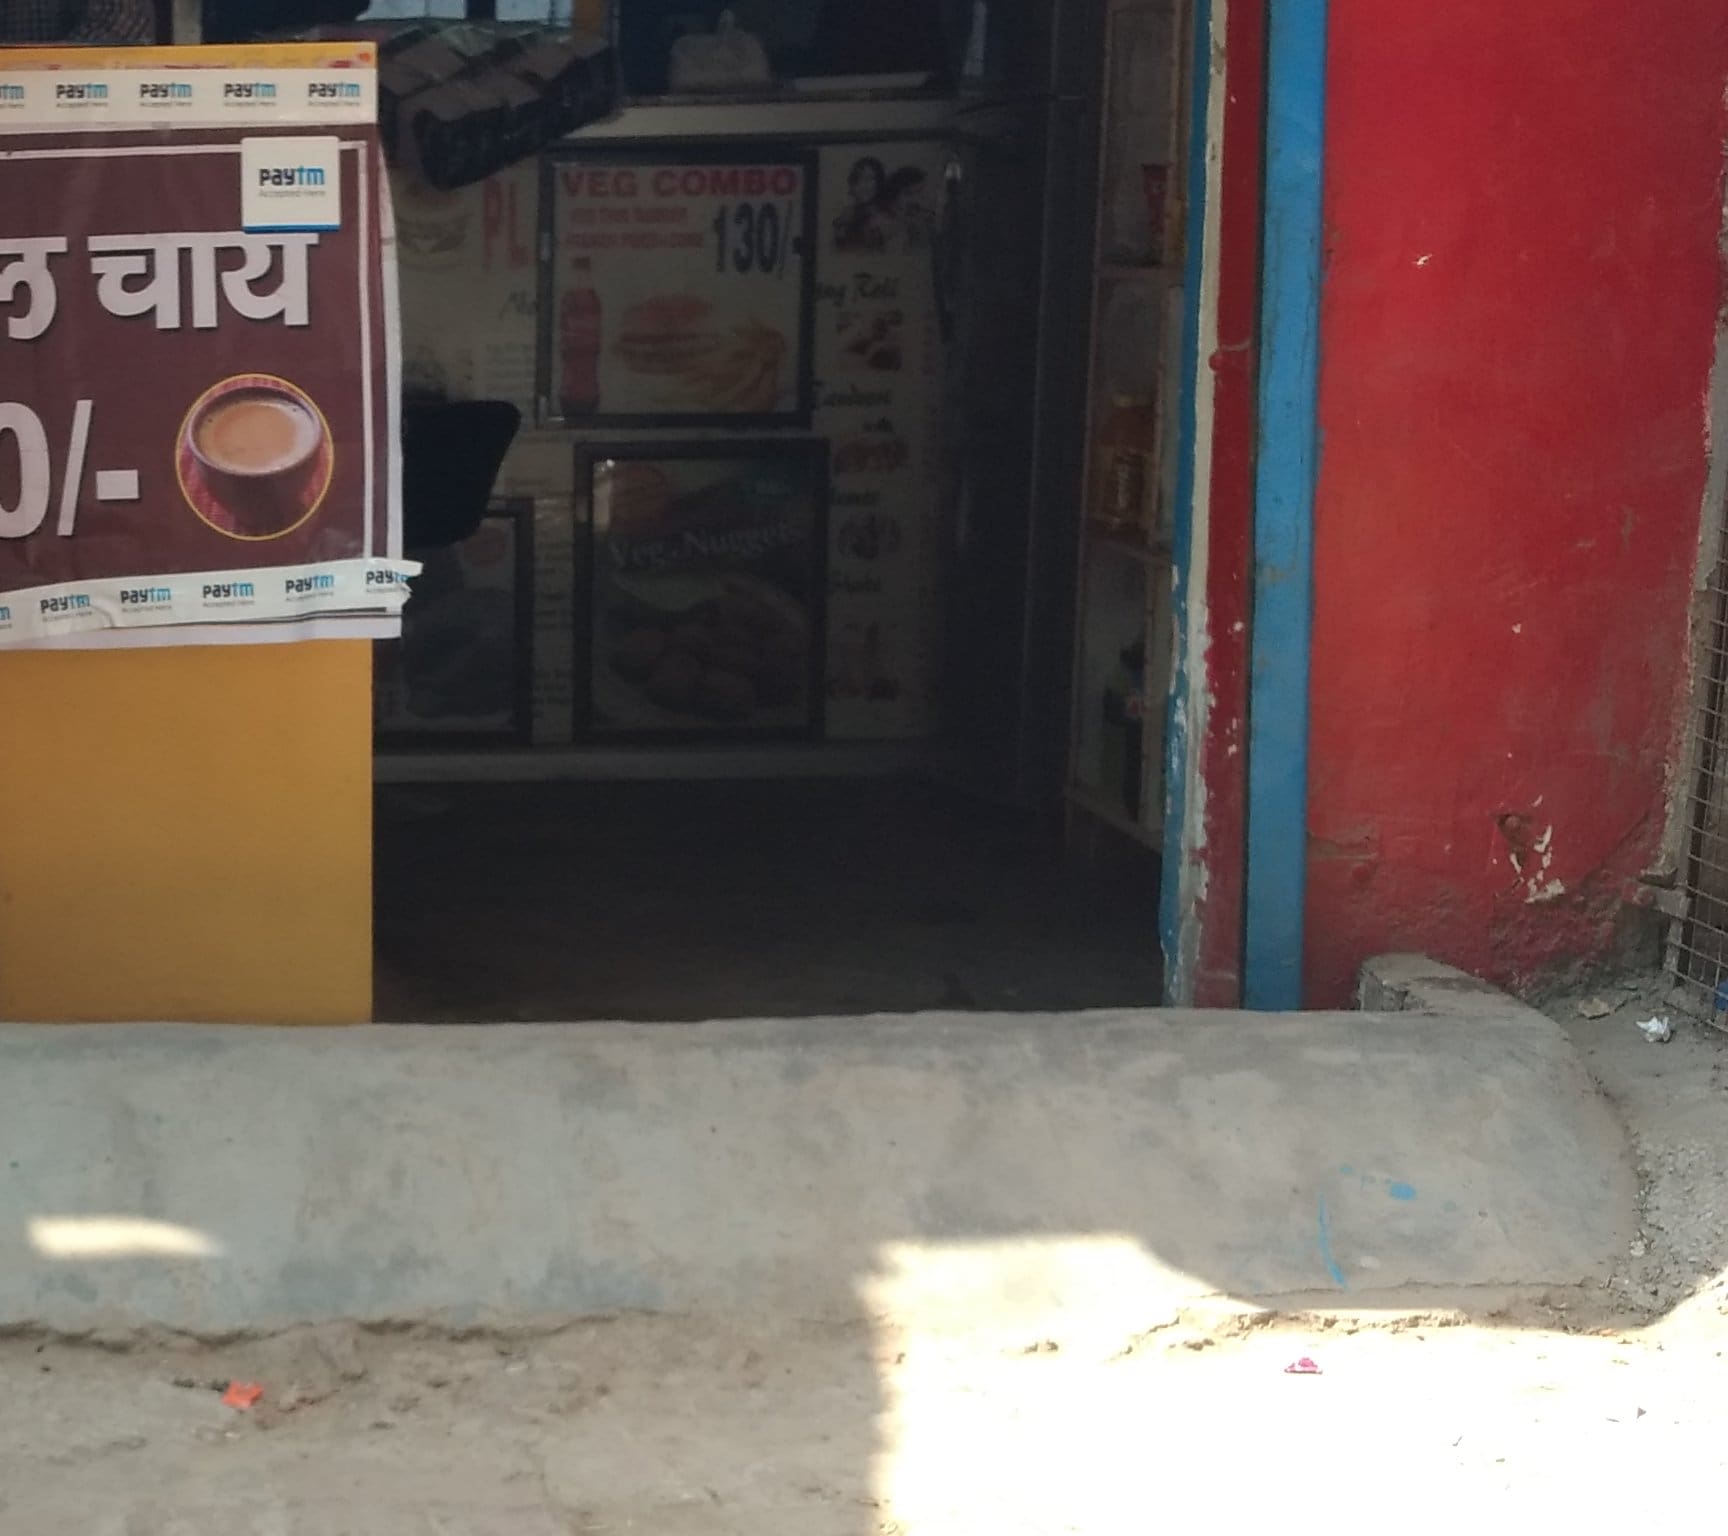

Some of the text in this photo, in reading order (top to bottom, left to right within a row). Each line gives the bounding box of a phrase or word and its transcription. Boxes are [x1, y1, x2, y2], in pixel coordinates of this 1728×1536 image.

[561, 168, 797, 197] VEG COMBO
[88, 231, 319, 330] चाय
